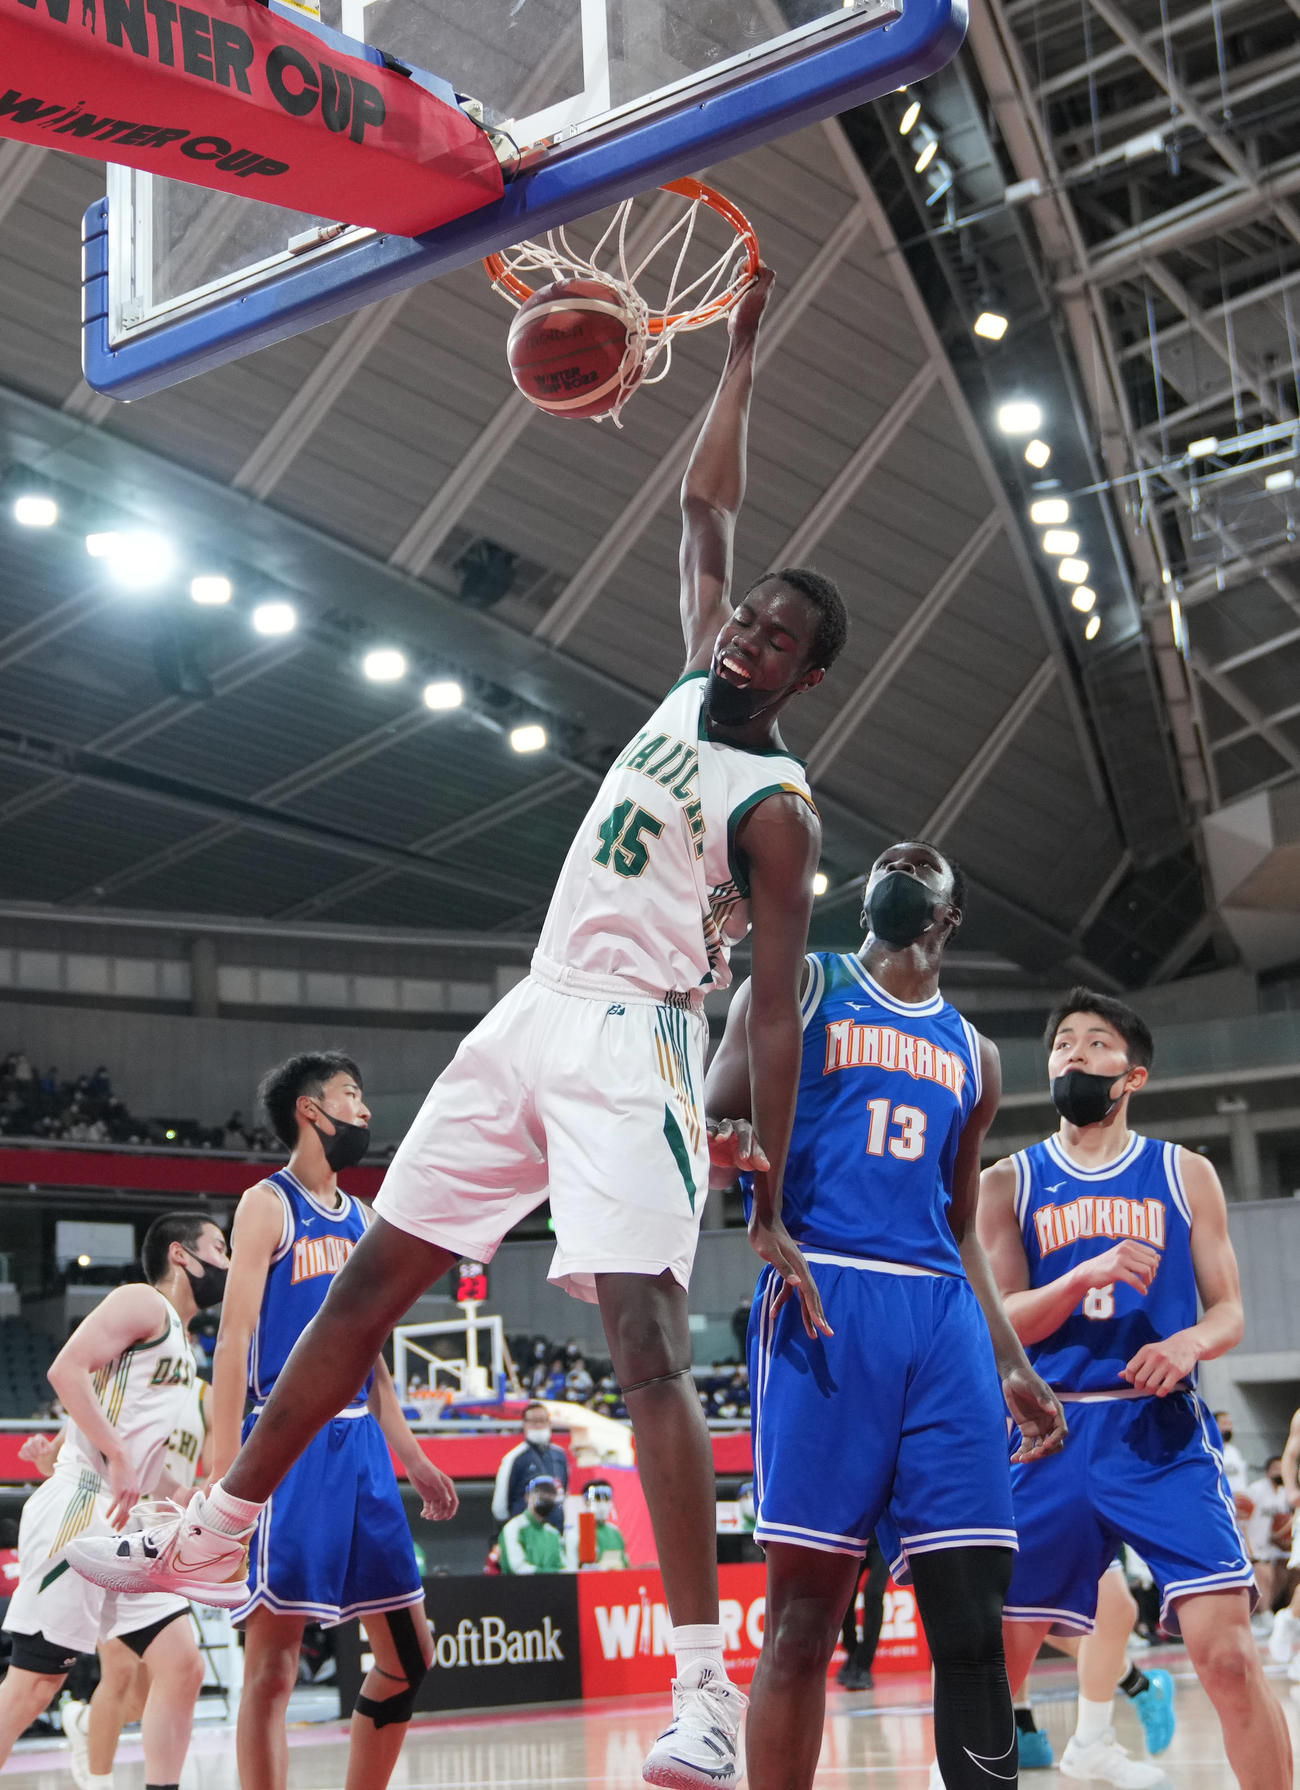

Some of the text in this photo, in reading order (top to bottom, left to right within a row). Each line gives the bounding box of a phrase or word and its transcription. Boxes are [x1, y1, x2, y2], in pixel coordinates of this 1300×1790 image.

[17, 0, 387, 144] NTER CUP
[180, 136, 290, 179] CUP
[592, 796, 665, 879] 45
[866, 1098, 927, 1162] 13
[1033, 1196, 1166, 1258] MINOKAMO
[1083, 1283, 1115, 1321] 8
